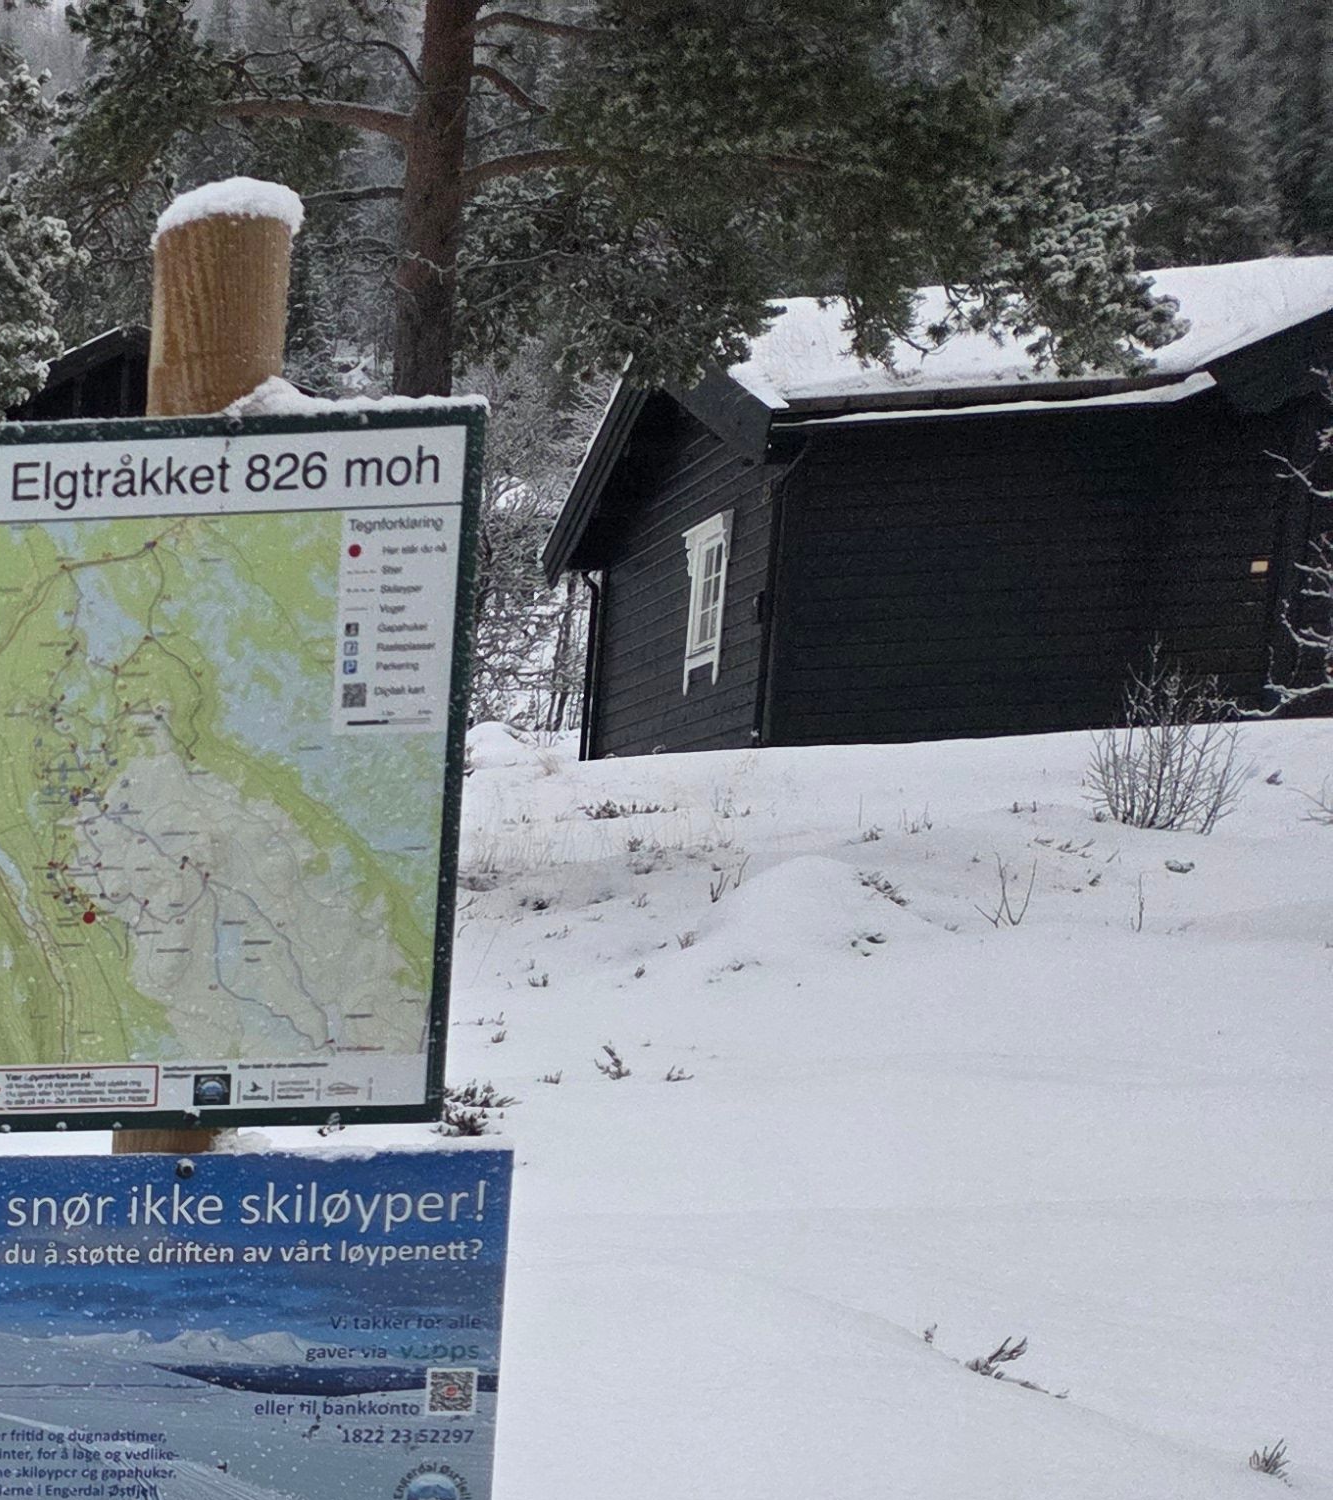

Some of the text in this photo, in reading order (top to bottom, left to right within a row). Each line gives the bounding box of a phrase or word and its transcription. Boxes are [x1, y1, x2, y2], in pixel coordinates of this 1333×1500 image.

[12, 445, 440, 510] Elgtråkket 826 moh
[348, 516, 444, 534] Tegnforklaring
[7, 1193, 116, 1230] snør
[131, 1184, 223, 1225] ikke
[240, 1180, 486, 1233] skiløyper!
[5, 1243, 36, 1265] du
[44, 1241, 58, 1265] å
[66, 1245, 140, 1266] støtte
[148, 1242, 234, 1264] driften
[243, 1245, 273, 1263] av
[281, 1239, 332, 1262] vårt
[340, 1239, 484, 1267] løypenett?
[330, 1314, 482, 1330] Vi takker for alle
[305, 1347, 353, 1362] gaver
[359, 1345, 388, 1359] via
[254, 1400, 420, 1416] eller til bankkonto
[10, 1429, 44, 1441] fritid
[48, 1432, 65, 1444] og
[68, 1430, 167, 1444] dugnadstimer,
[342, 1428, 384, 1444] 1822
[390, 1428, 413, 1444] 23
[37, 1447, 57, 1460] for
[73, 1448, 101, 1463] lage
[104, 1450, 121, 1463] og
[124, 1448, 179, 1461] vedlike-
[101, 1467, 177, 1481] gapahuker.
[37, 1484, 41, 1496] i
[45, 1483, 104, 1498] Engerdal
